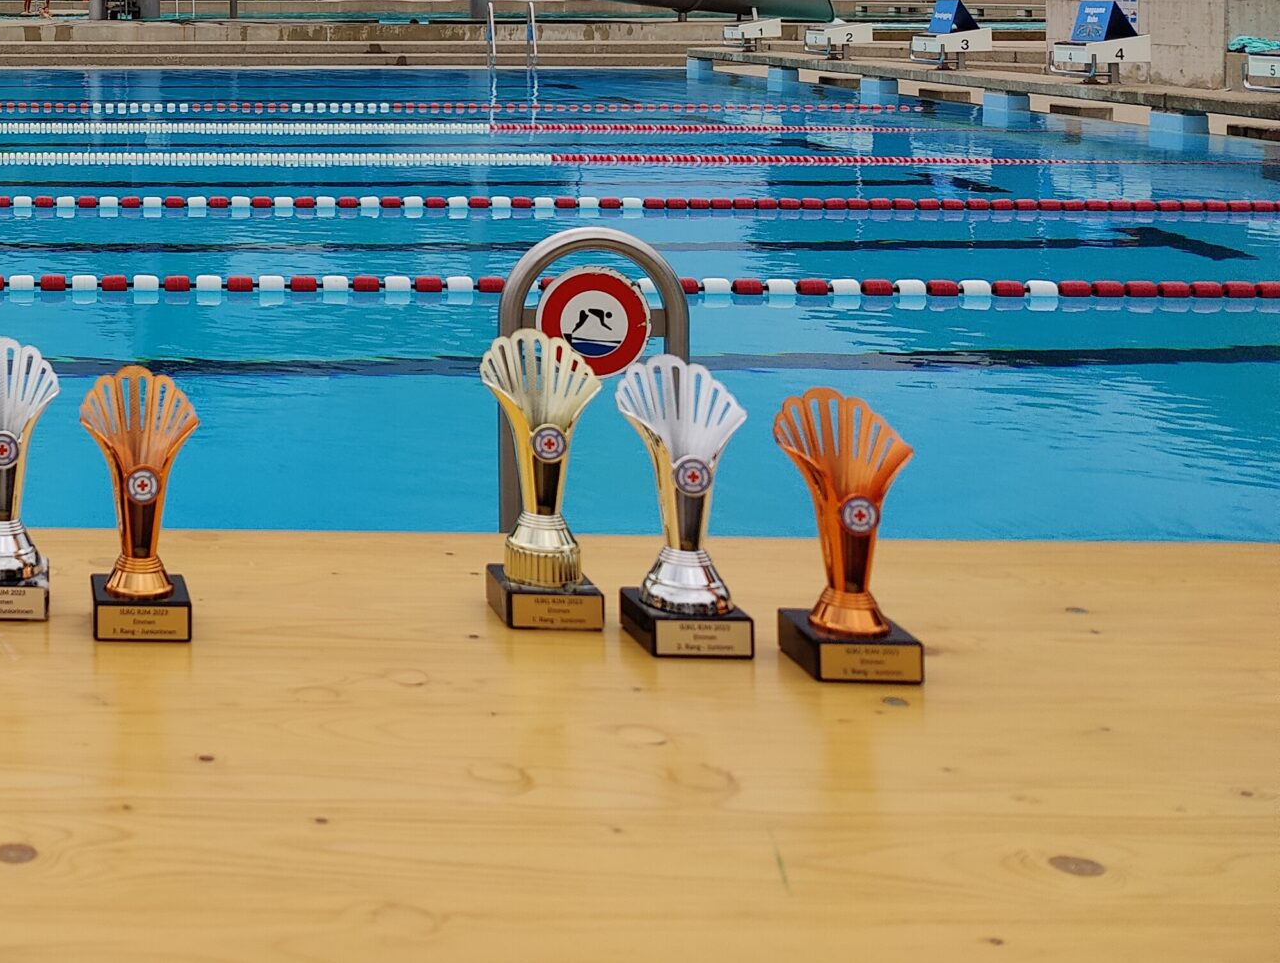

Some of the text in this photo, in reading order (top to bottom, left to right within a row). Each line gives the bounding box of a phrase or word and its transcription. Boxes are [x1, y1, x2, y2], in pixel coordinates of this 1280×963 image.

[758, 28, 763, 36] 1
[846, 33, 853, 42] 2
[960, 39, 970, 50] 3
[1068, 52, 1072, 61] 4
[1115, 48, 1124, 60] 4
[1270, 64, 1276, 76] 5
